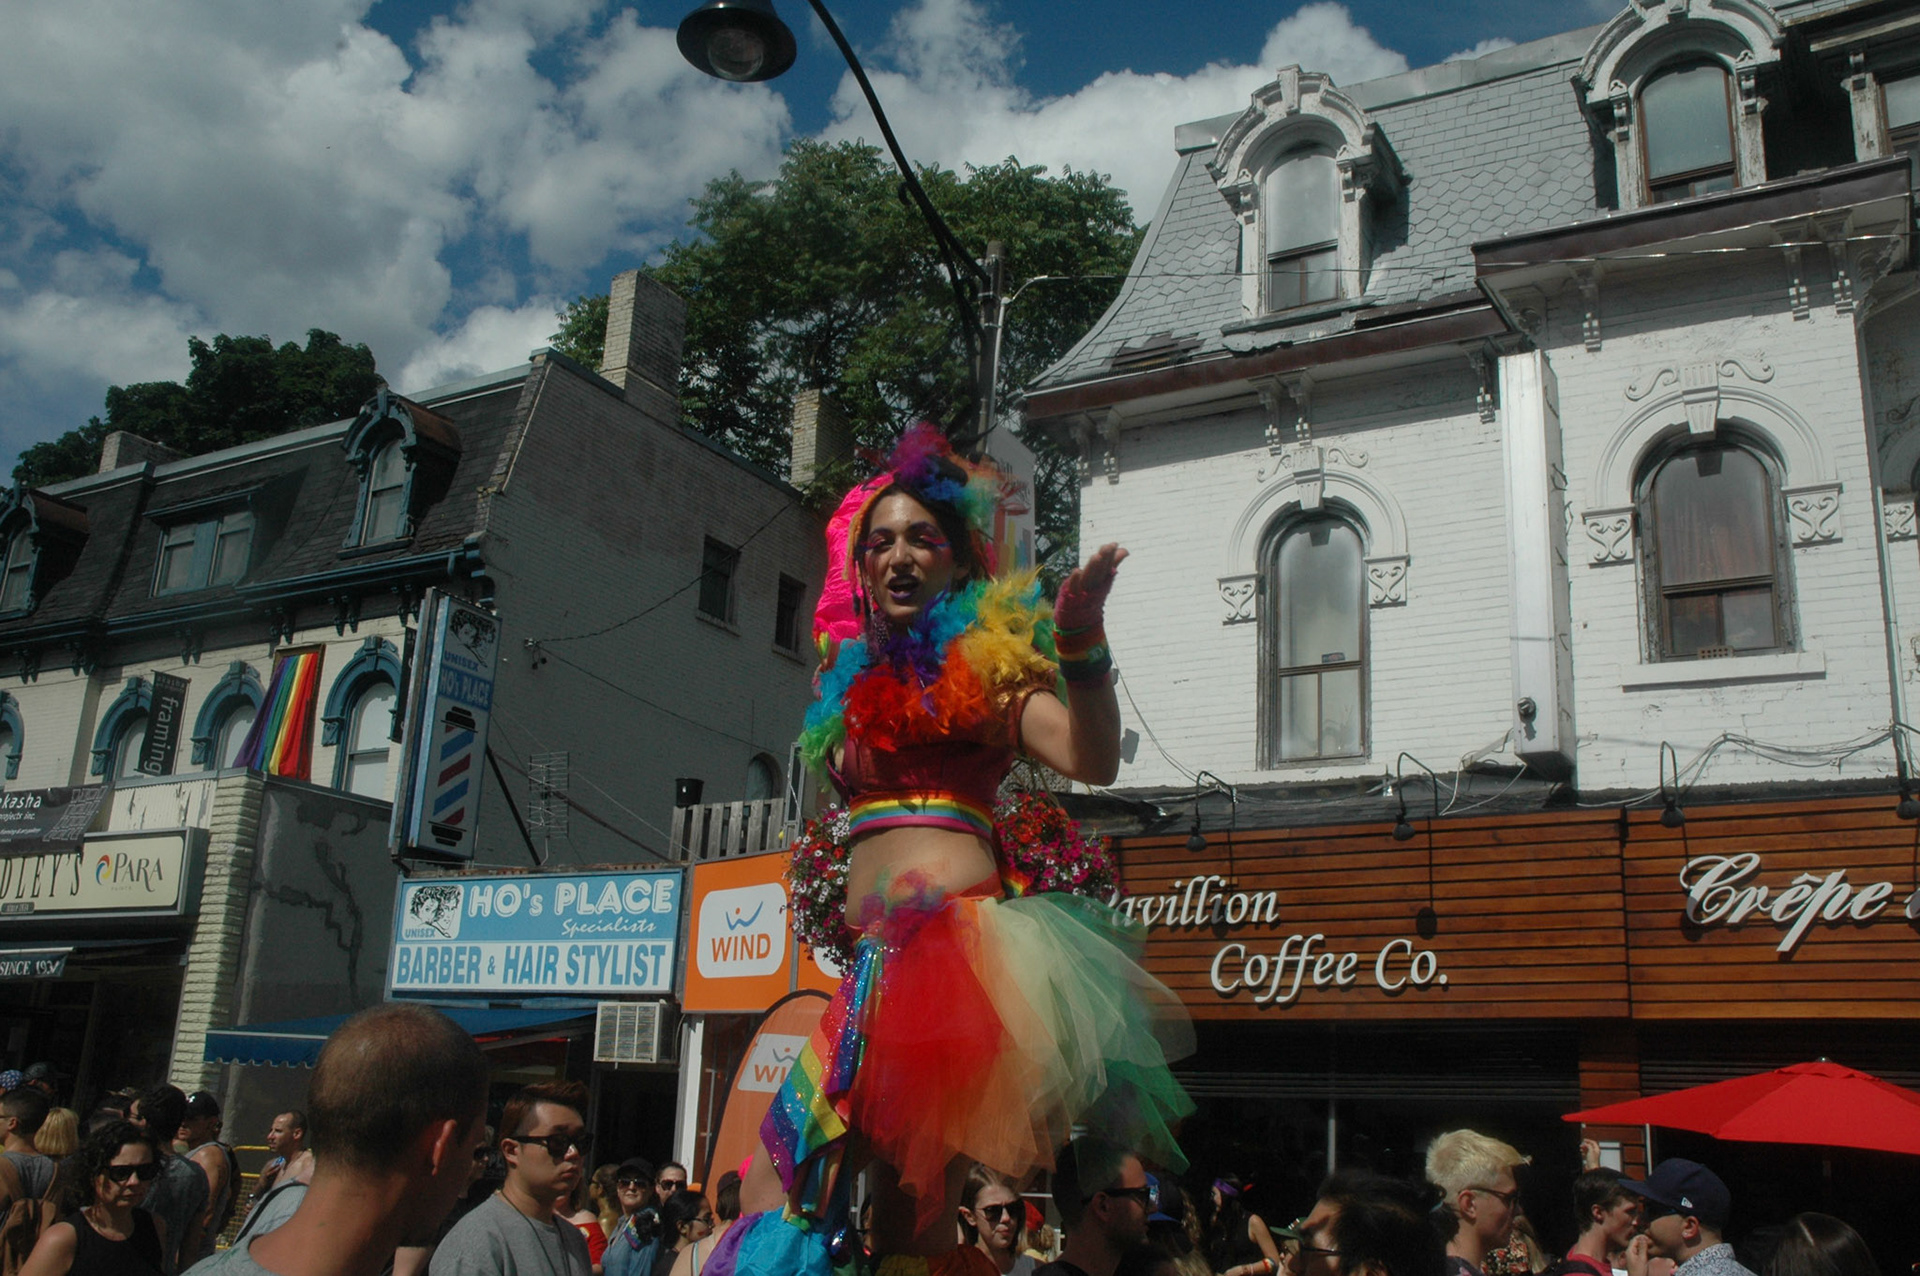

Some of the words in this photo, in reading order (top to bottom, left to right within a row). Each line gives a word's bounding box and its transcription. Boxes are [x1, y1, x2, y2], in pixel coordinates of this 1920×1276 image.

[444, 650, 479, 672] UNISEX
[461, 674, 491, 708] PLACE
[143, 696, 179, 775] framing
[0, 793, 42, 809] kasha
[113, 852, 163, 892] PARA
[468, 883, 543, 918] HO's
[554, 879, 674, 916] PLACE
[1680, 853, 1893, 952] Crêpe
[404, 928, 436, 939] UNISEX
[561, 917, 657, 938] Specialists
[711, 933, 772, 963] WIND
[0, 960, 31, 976] SINCE
[396, 946, 482, 984] BARBER
[487, 955, 496, 976] &
[502, 945, 560, 985] HAIR
[565, 944, 667, 987] STYLIST
[1211, 933, 1358, 1003] Coffee
[1375, 938, 1448, 990] Co.
[754, 1064, 791, 1084] WI
